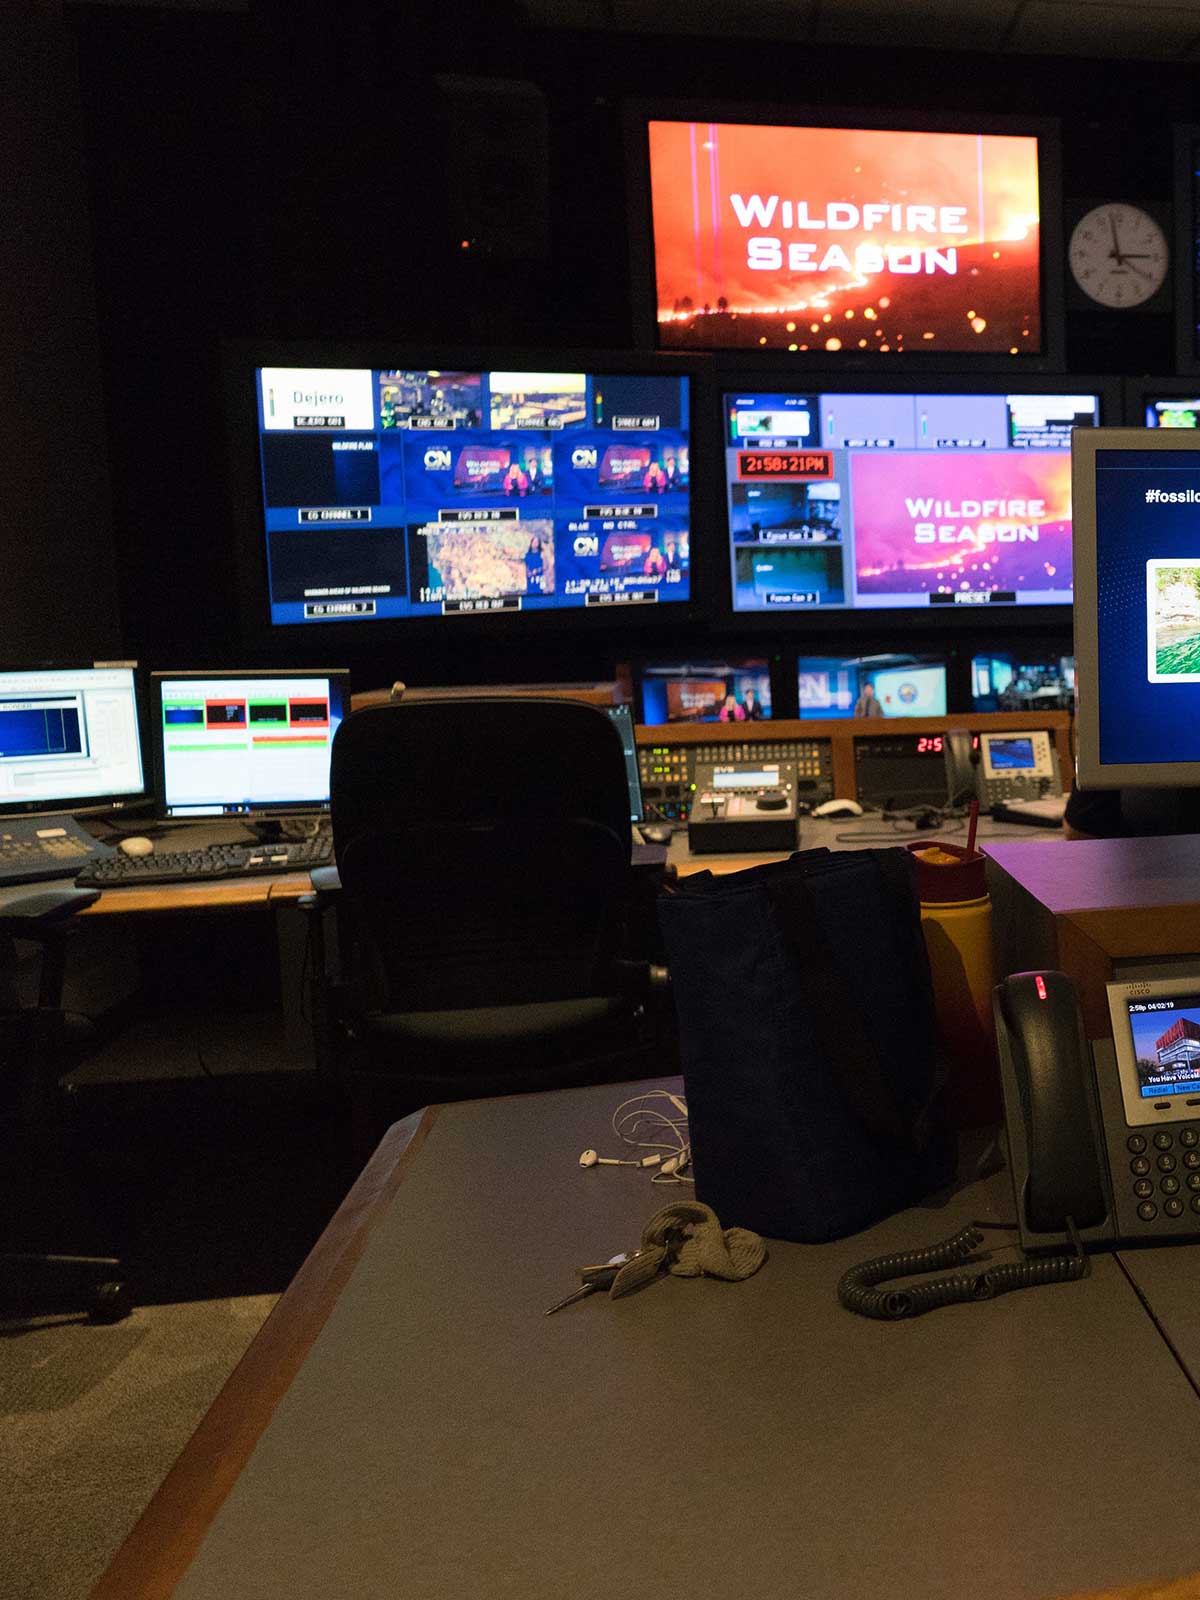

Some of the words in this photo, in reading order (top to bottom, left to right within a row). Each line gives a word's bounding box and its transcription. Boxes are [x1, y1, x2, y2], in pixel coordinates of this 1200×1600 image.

[729, 193, 969, 234] WILDFIRE
[746, 237, 958, 276] SEASON
[293, 390, 344, 408] Dejero
[904, 497, 1046, 518] WILDFIRE
[1148, 1001, 1175, 1011] 04/02/19
[1161, 1074, 1177, 1082] Have
